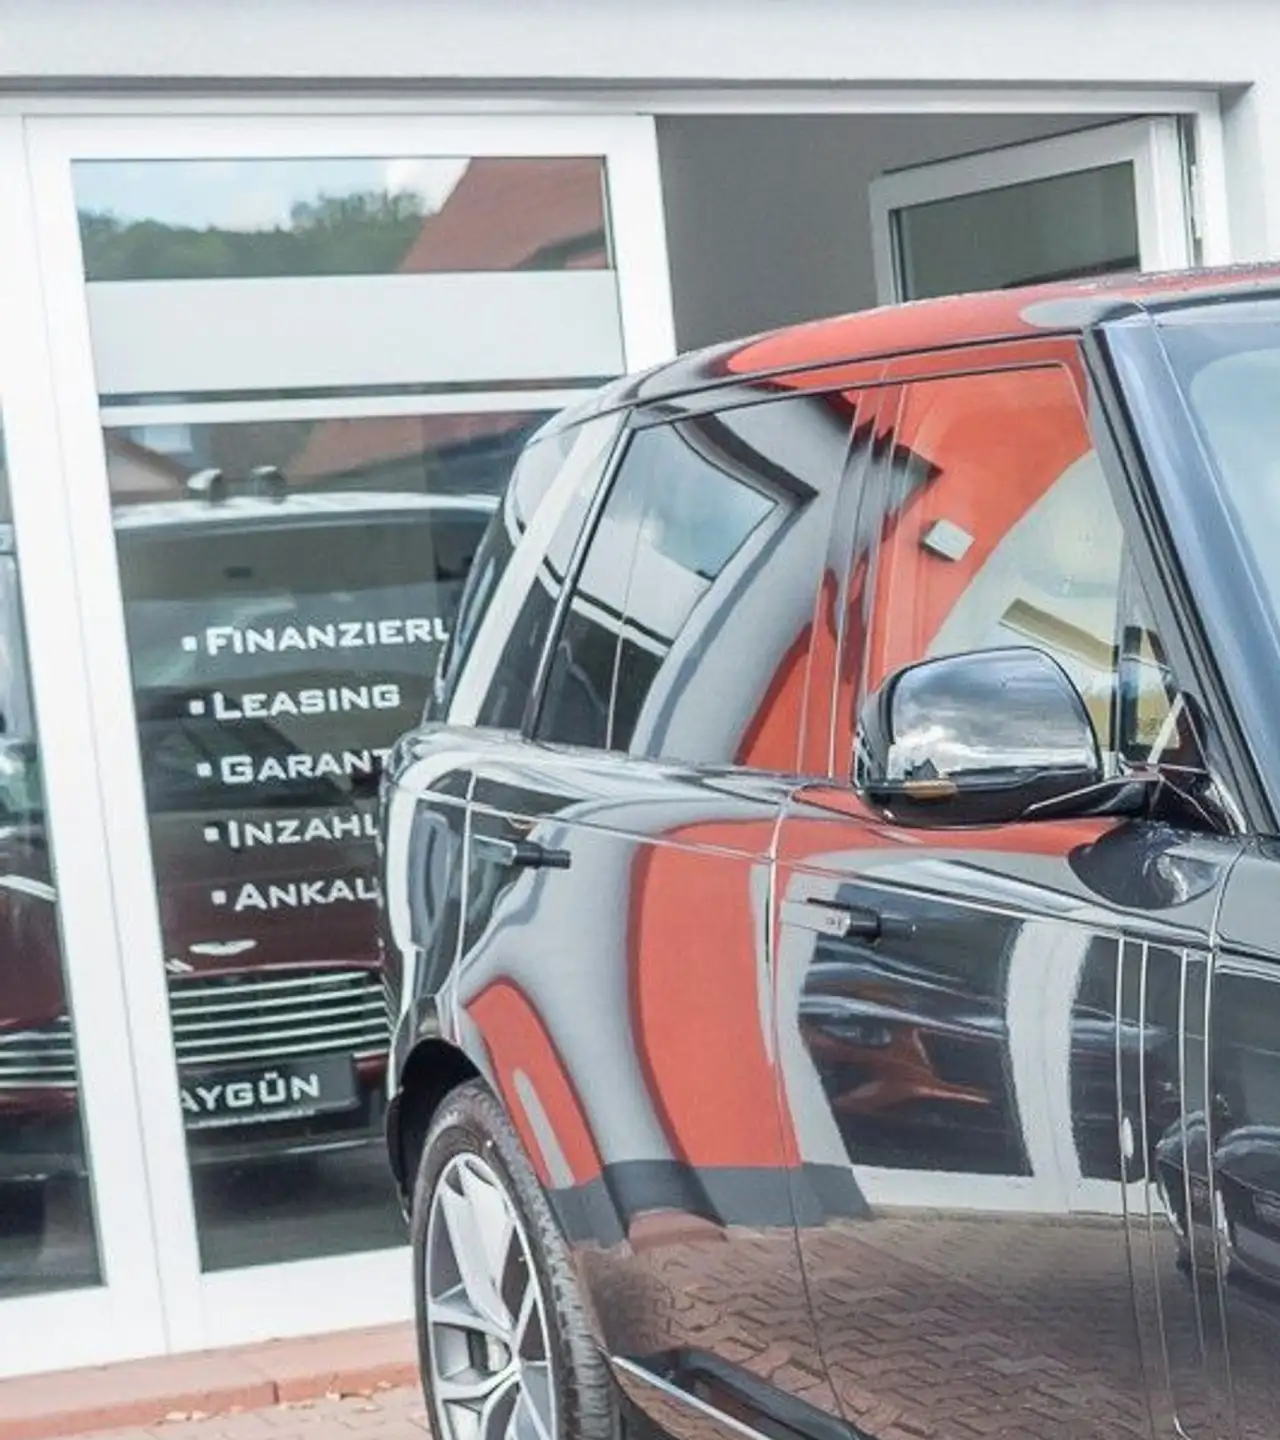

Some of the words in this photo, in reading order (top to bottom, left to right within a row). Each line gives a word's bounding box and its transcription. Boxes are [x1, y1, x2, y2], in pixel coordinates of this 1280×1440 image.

[211, 684, 401, 721] LEASING
[219, 748, 394, 785] GARANT
[179, 1069, 321, 1113] AYGÜN
